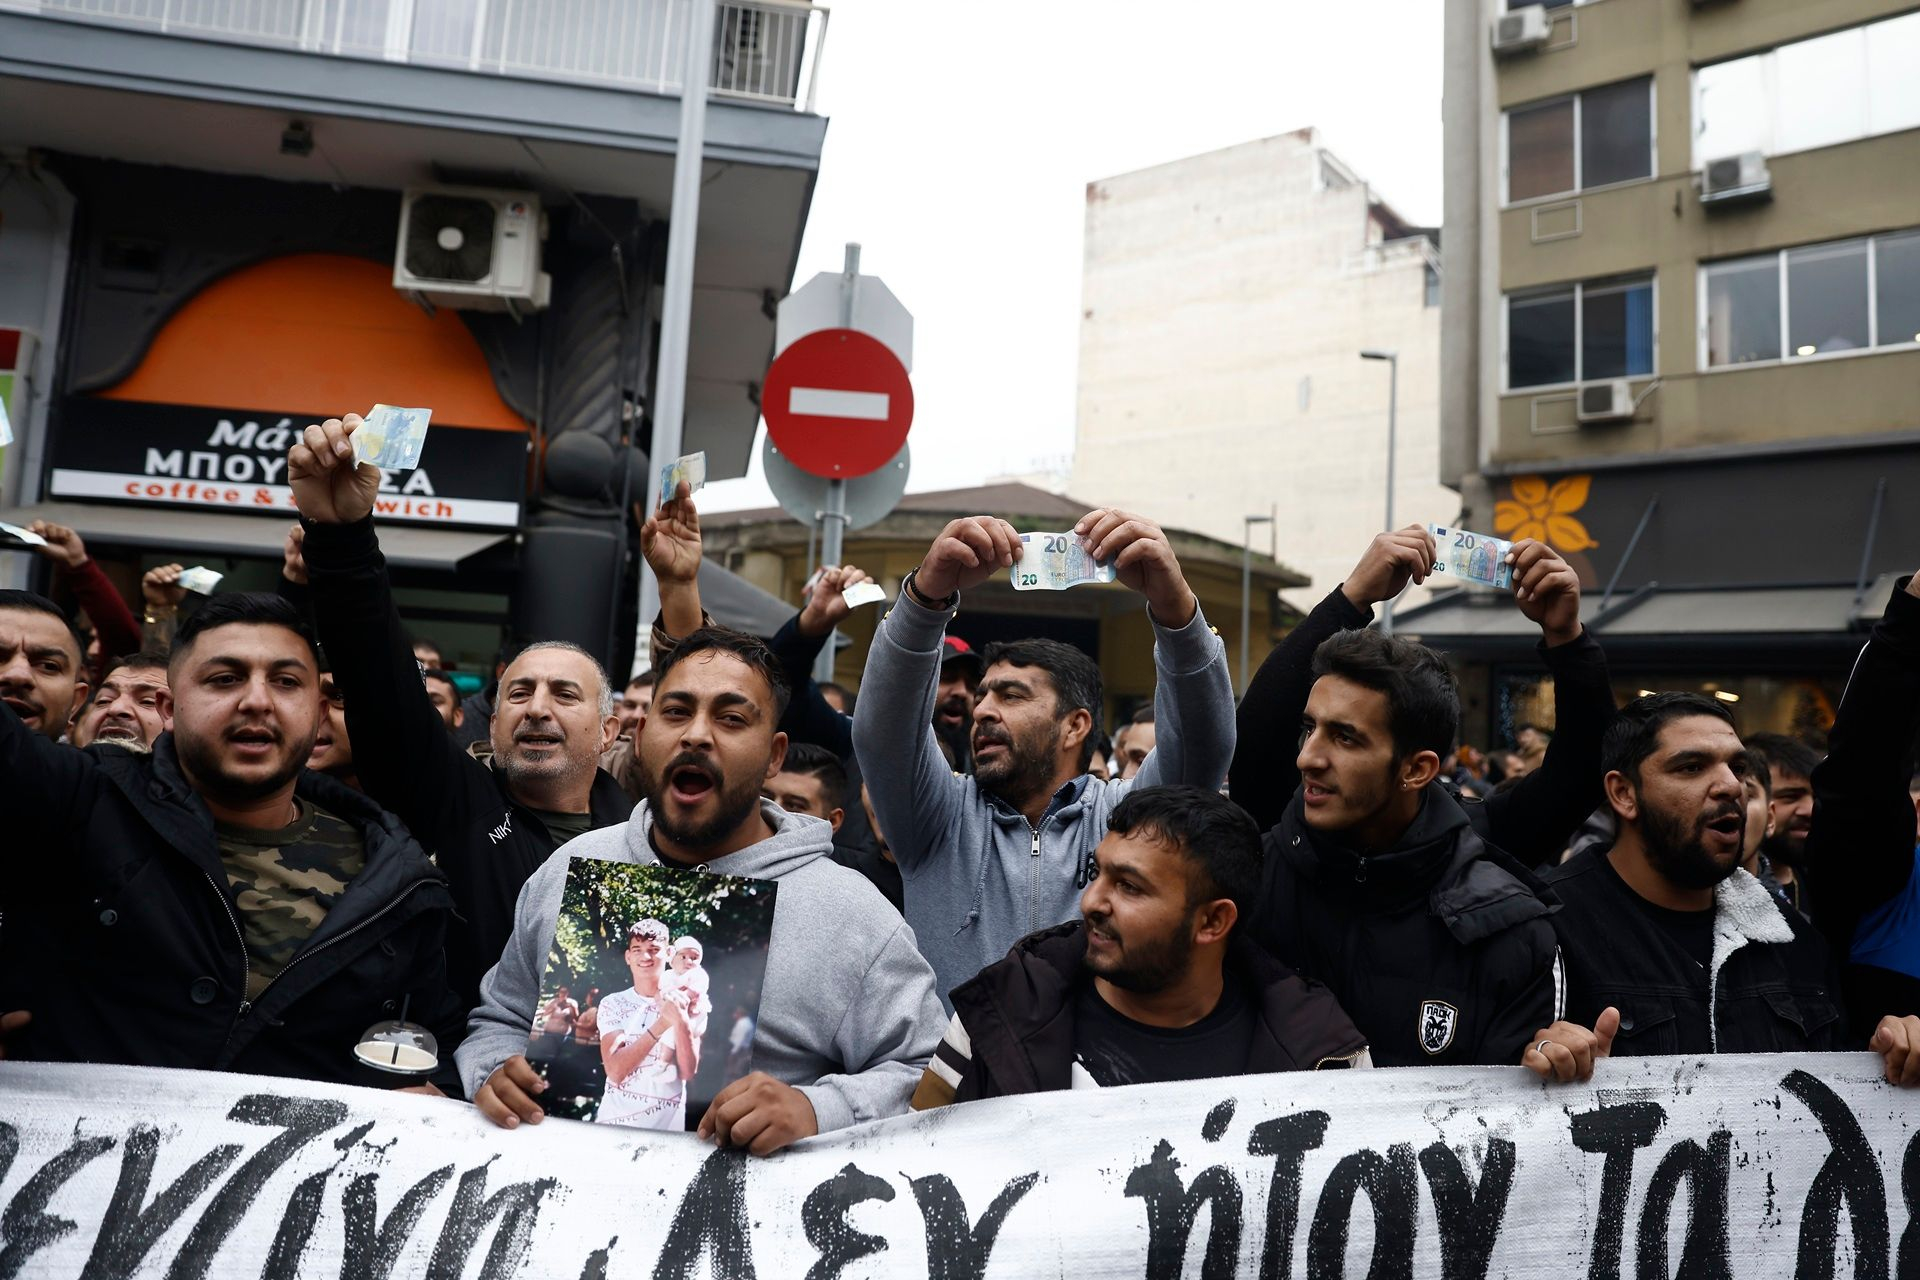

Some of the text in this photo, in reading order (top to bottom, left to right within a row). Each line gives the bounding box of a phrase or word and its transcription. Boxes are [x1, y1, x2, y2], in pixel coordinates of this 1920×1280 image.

[126, 481, 240, 503] coffee
[253, 487, 274, 506] &
[1043, 536, 1068, 554] 20
[1454, 532, 1475, 550] 20
[1432, 561, 1446, 572] 20
[1021, 574, 1038, 586] 20
